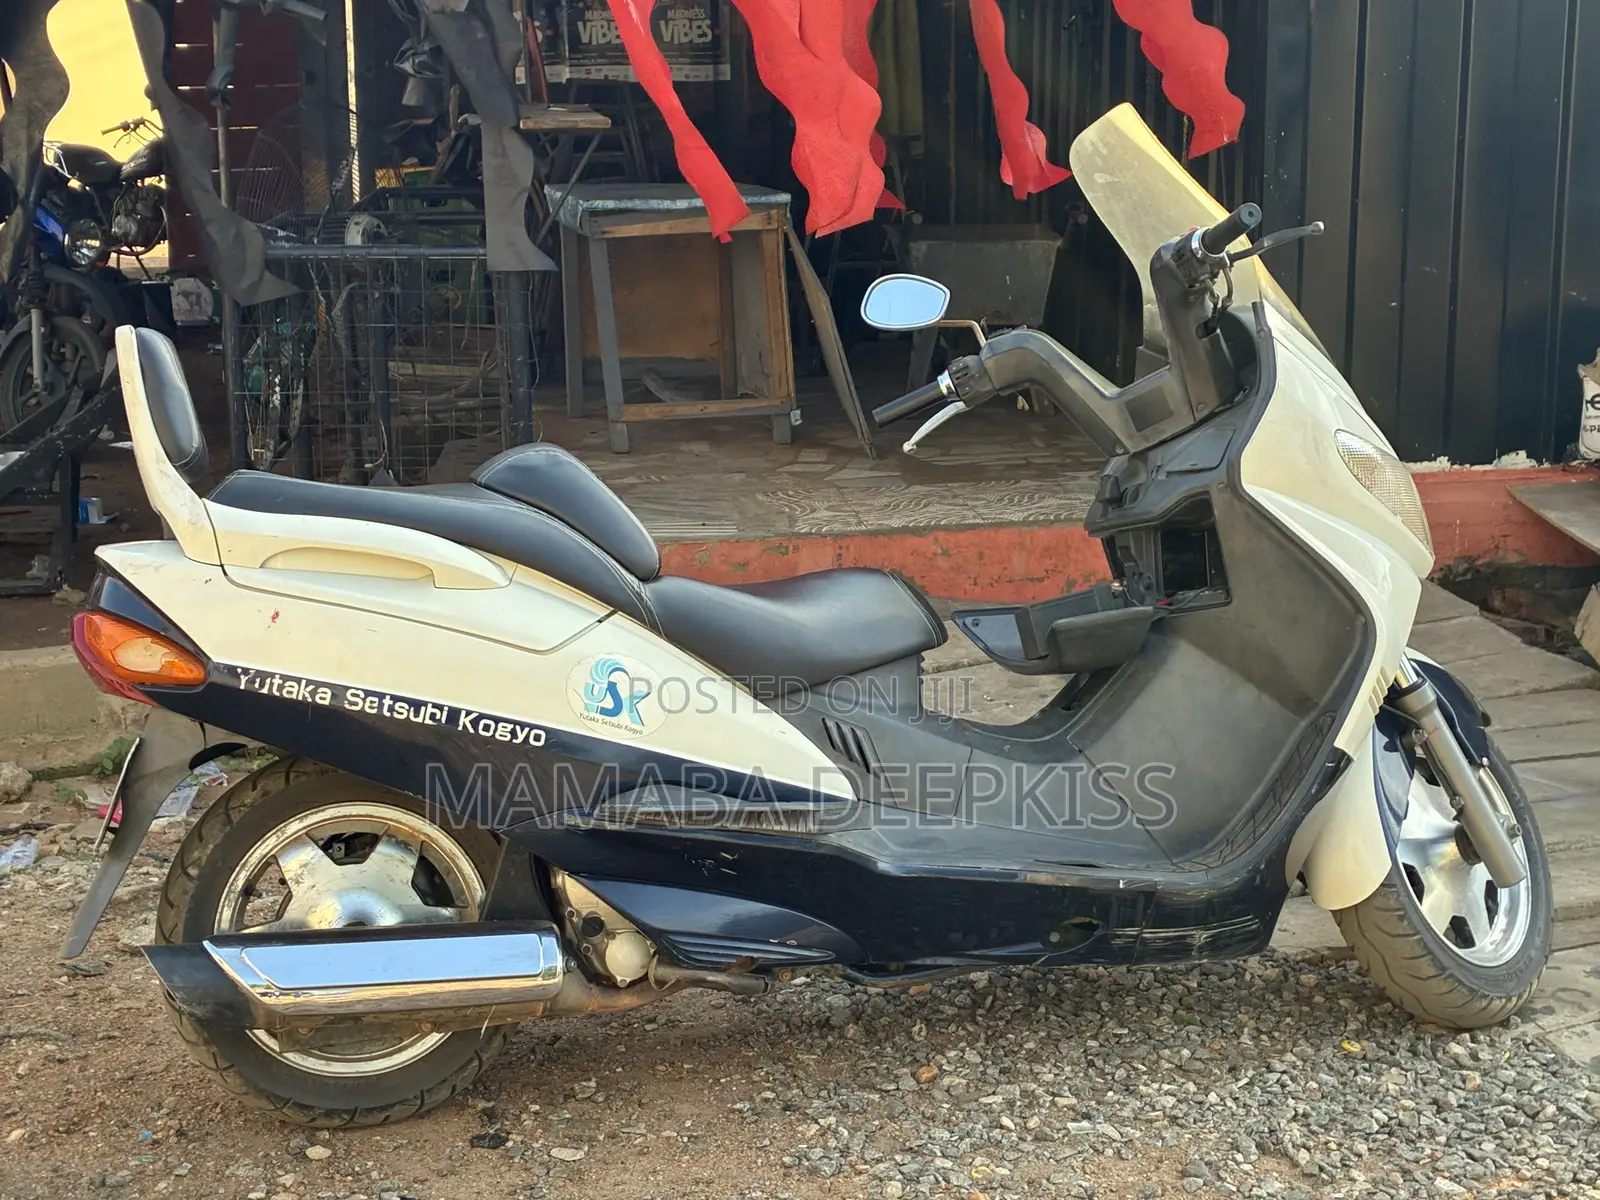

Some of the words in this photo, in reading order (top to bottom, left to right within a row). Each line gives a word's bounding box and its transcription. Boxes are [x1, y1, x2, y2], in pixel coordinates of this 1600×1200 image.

[577, 21, 622, 45] ViBE
[236, 667, 331, 706] Yutaka
[344, 688, 448, 725] Setsubi
[457, 709, 546, 747] Kogyo
[579, 712, 600, 723] Yutaka
[601, 719, 624, 729] Setsubi
[624, 725, 644, 735] Kogyo
